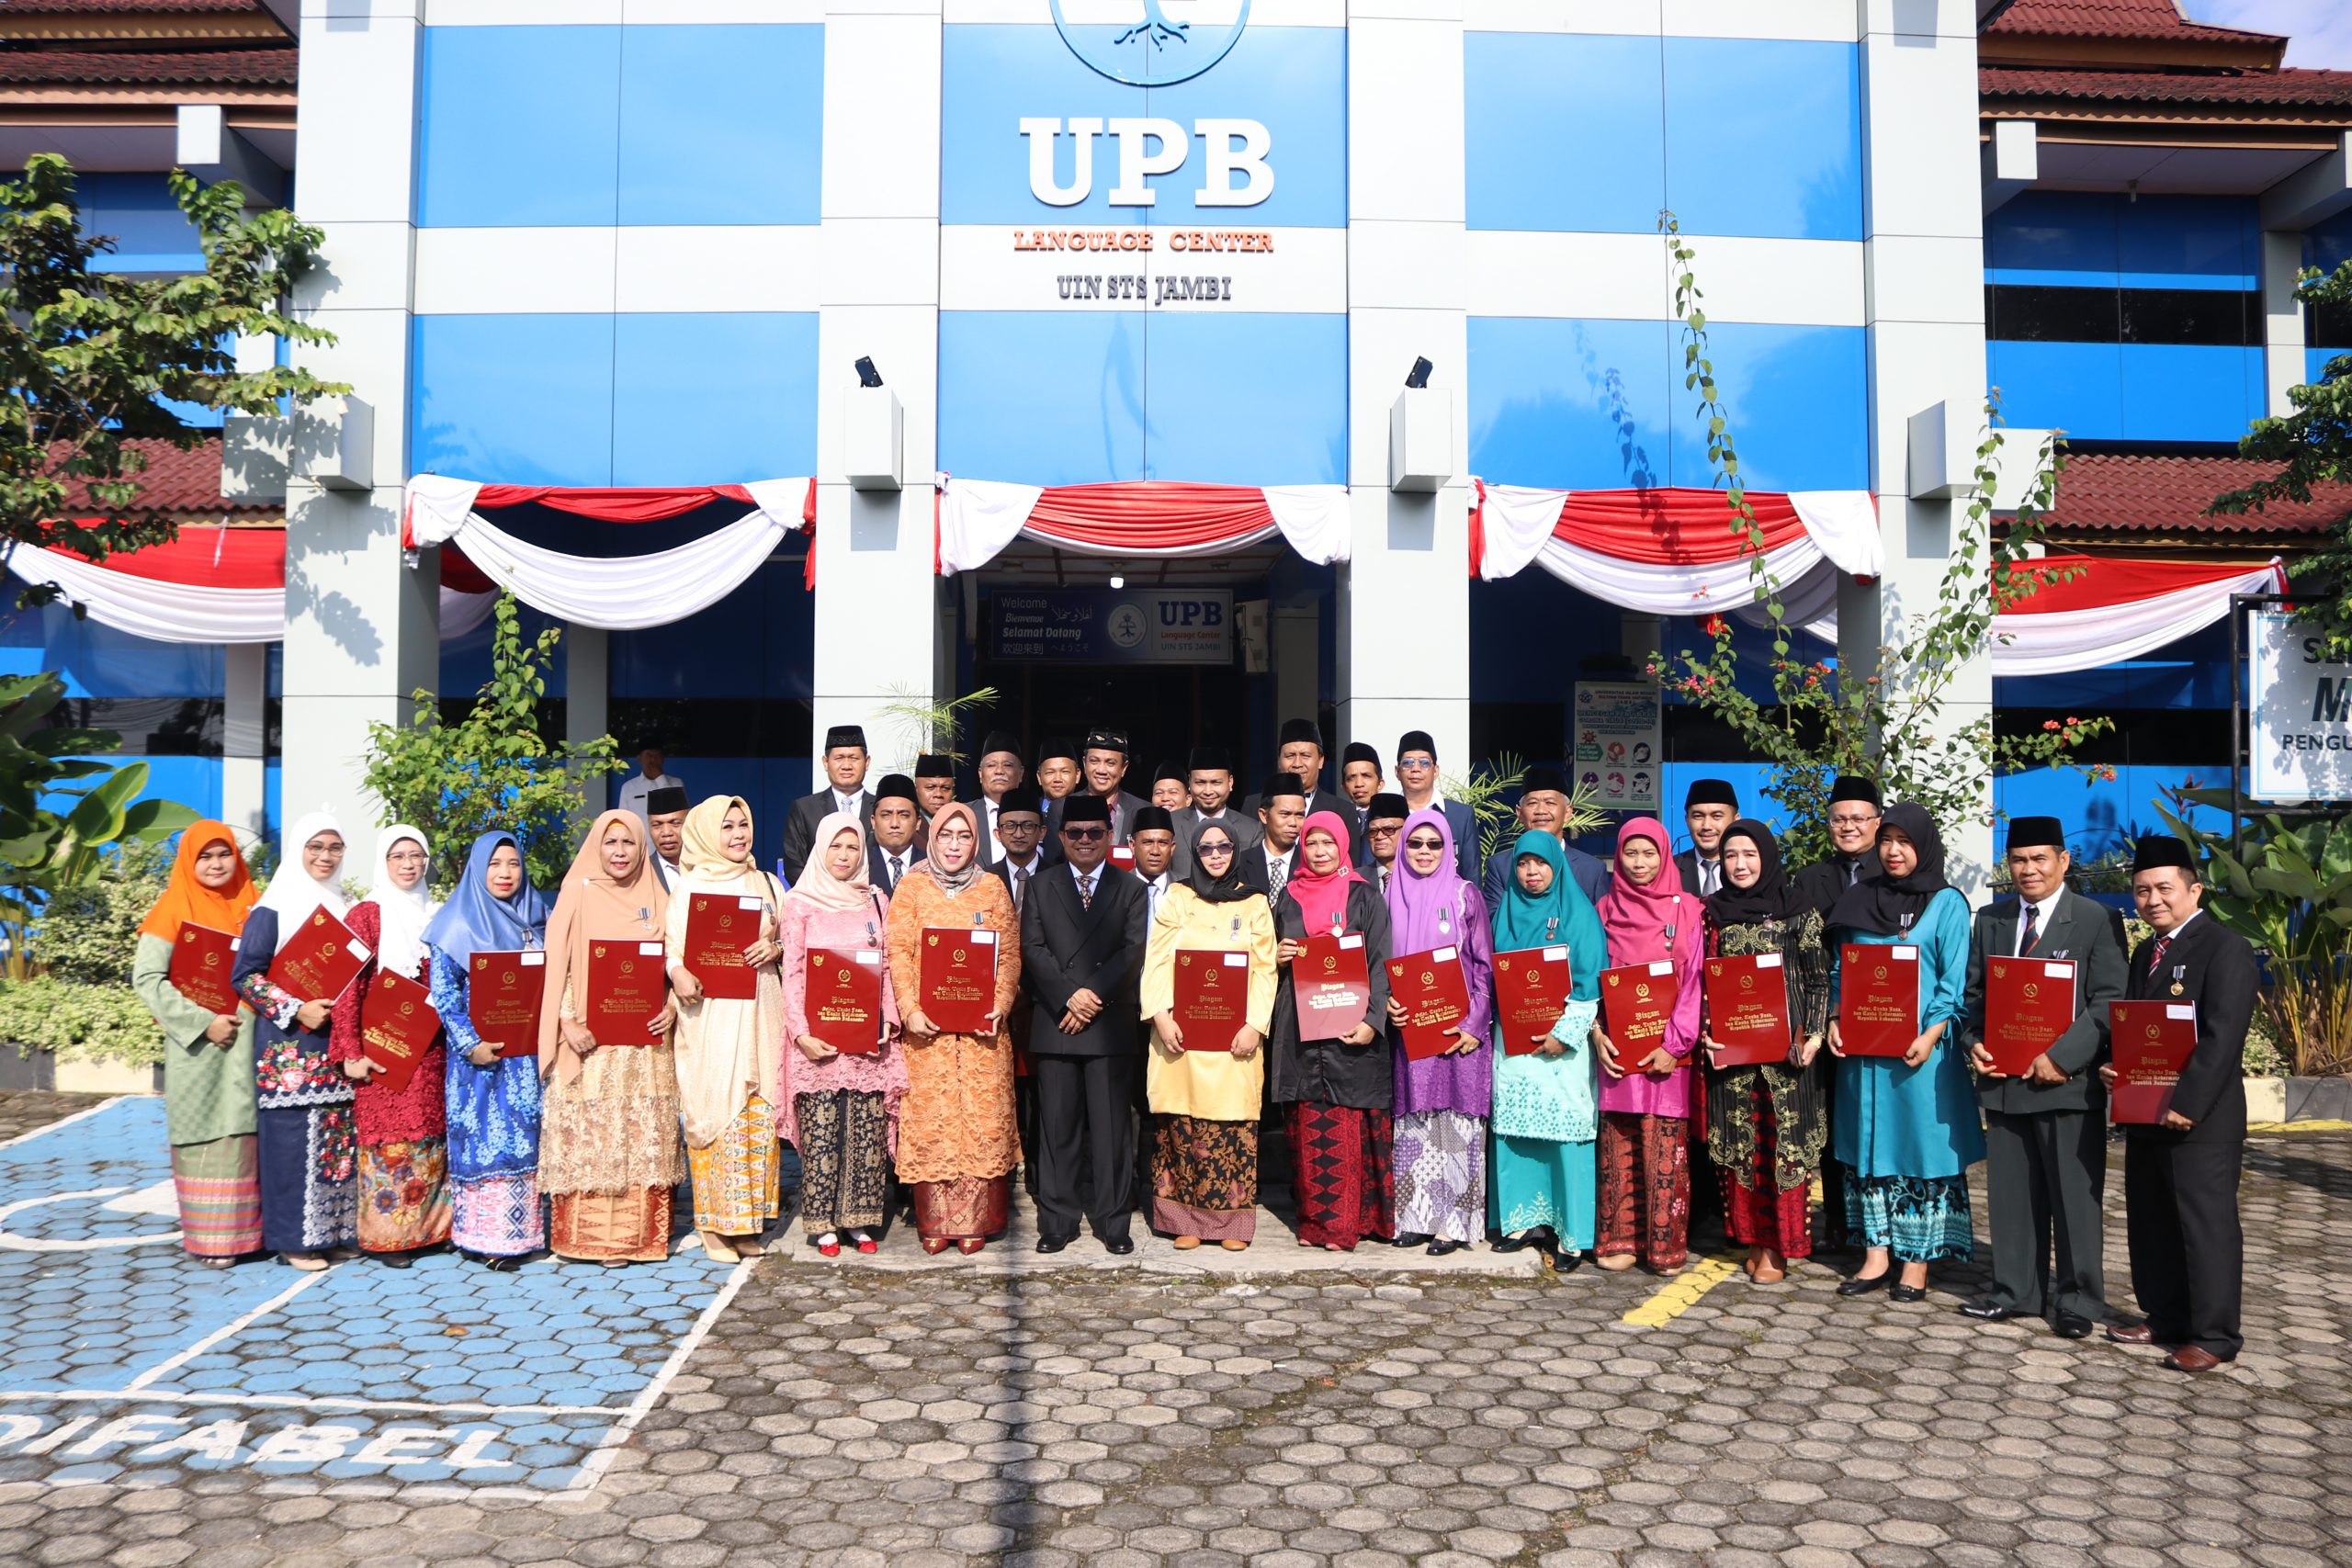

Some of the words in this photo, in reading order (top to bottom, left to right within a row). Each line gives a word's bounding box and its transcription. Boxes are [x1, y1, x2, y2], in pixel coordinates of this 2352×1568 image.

[1020, 117, 1274, 208] UPB
[1013, 231, 1154, 252] LANGUAGE
[1170, 231, 1274, 254] CENTER
[1057, 275, 1102, 299] UIN
[1107, 275, 1148, 299] STS
[1155, 276, 1232, 305] JAMBI
[1001, 596, 1047, 608] Welcome
[1005, 613, 1044, 623] Bienvenue
[1159, 601, 1222, 626] UPB
[1002, 626, 1043, 637] Selamat
[1046, 627, 1081, 640] Datang
[1160, 631, 1195, 640] Language
[1197, 631, 1220, 639] Center
